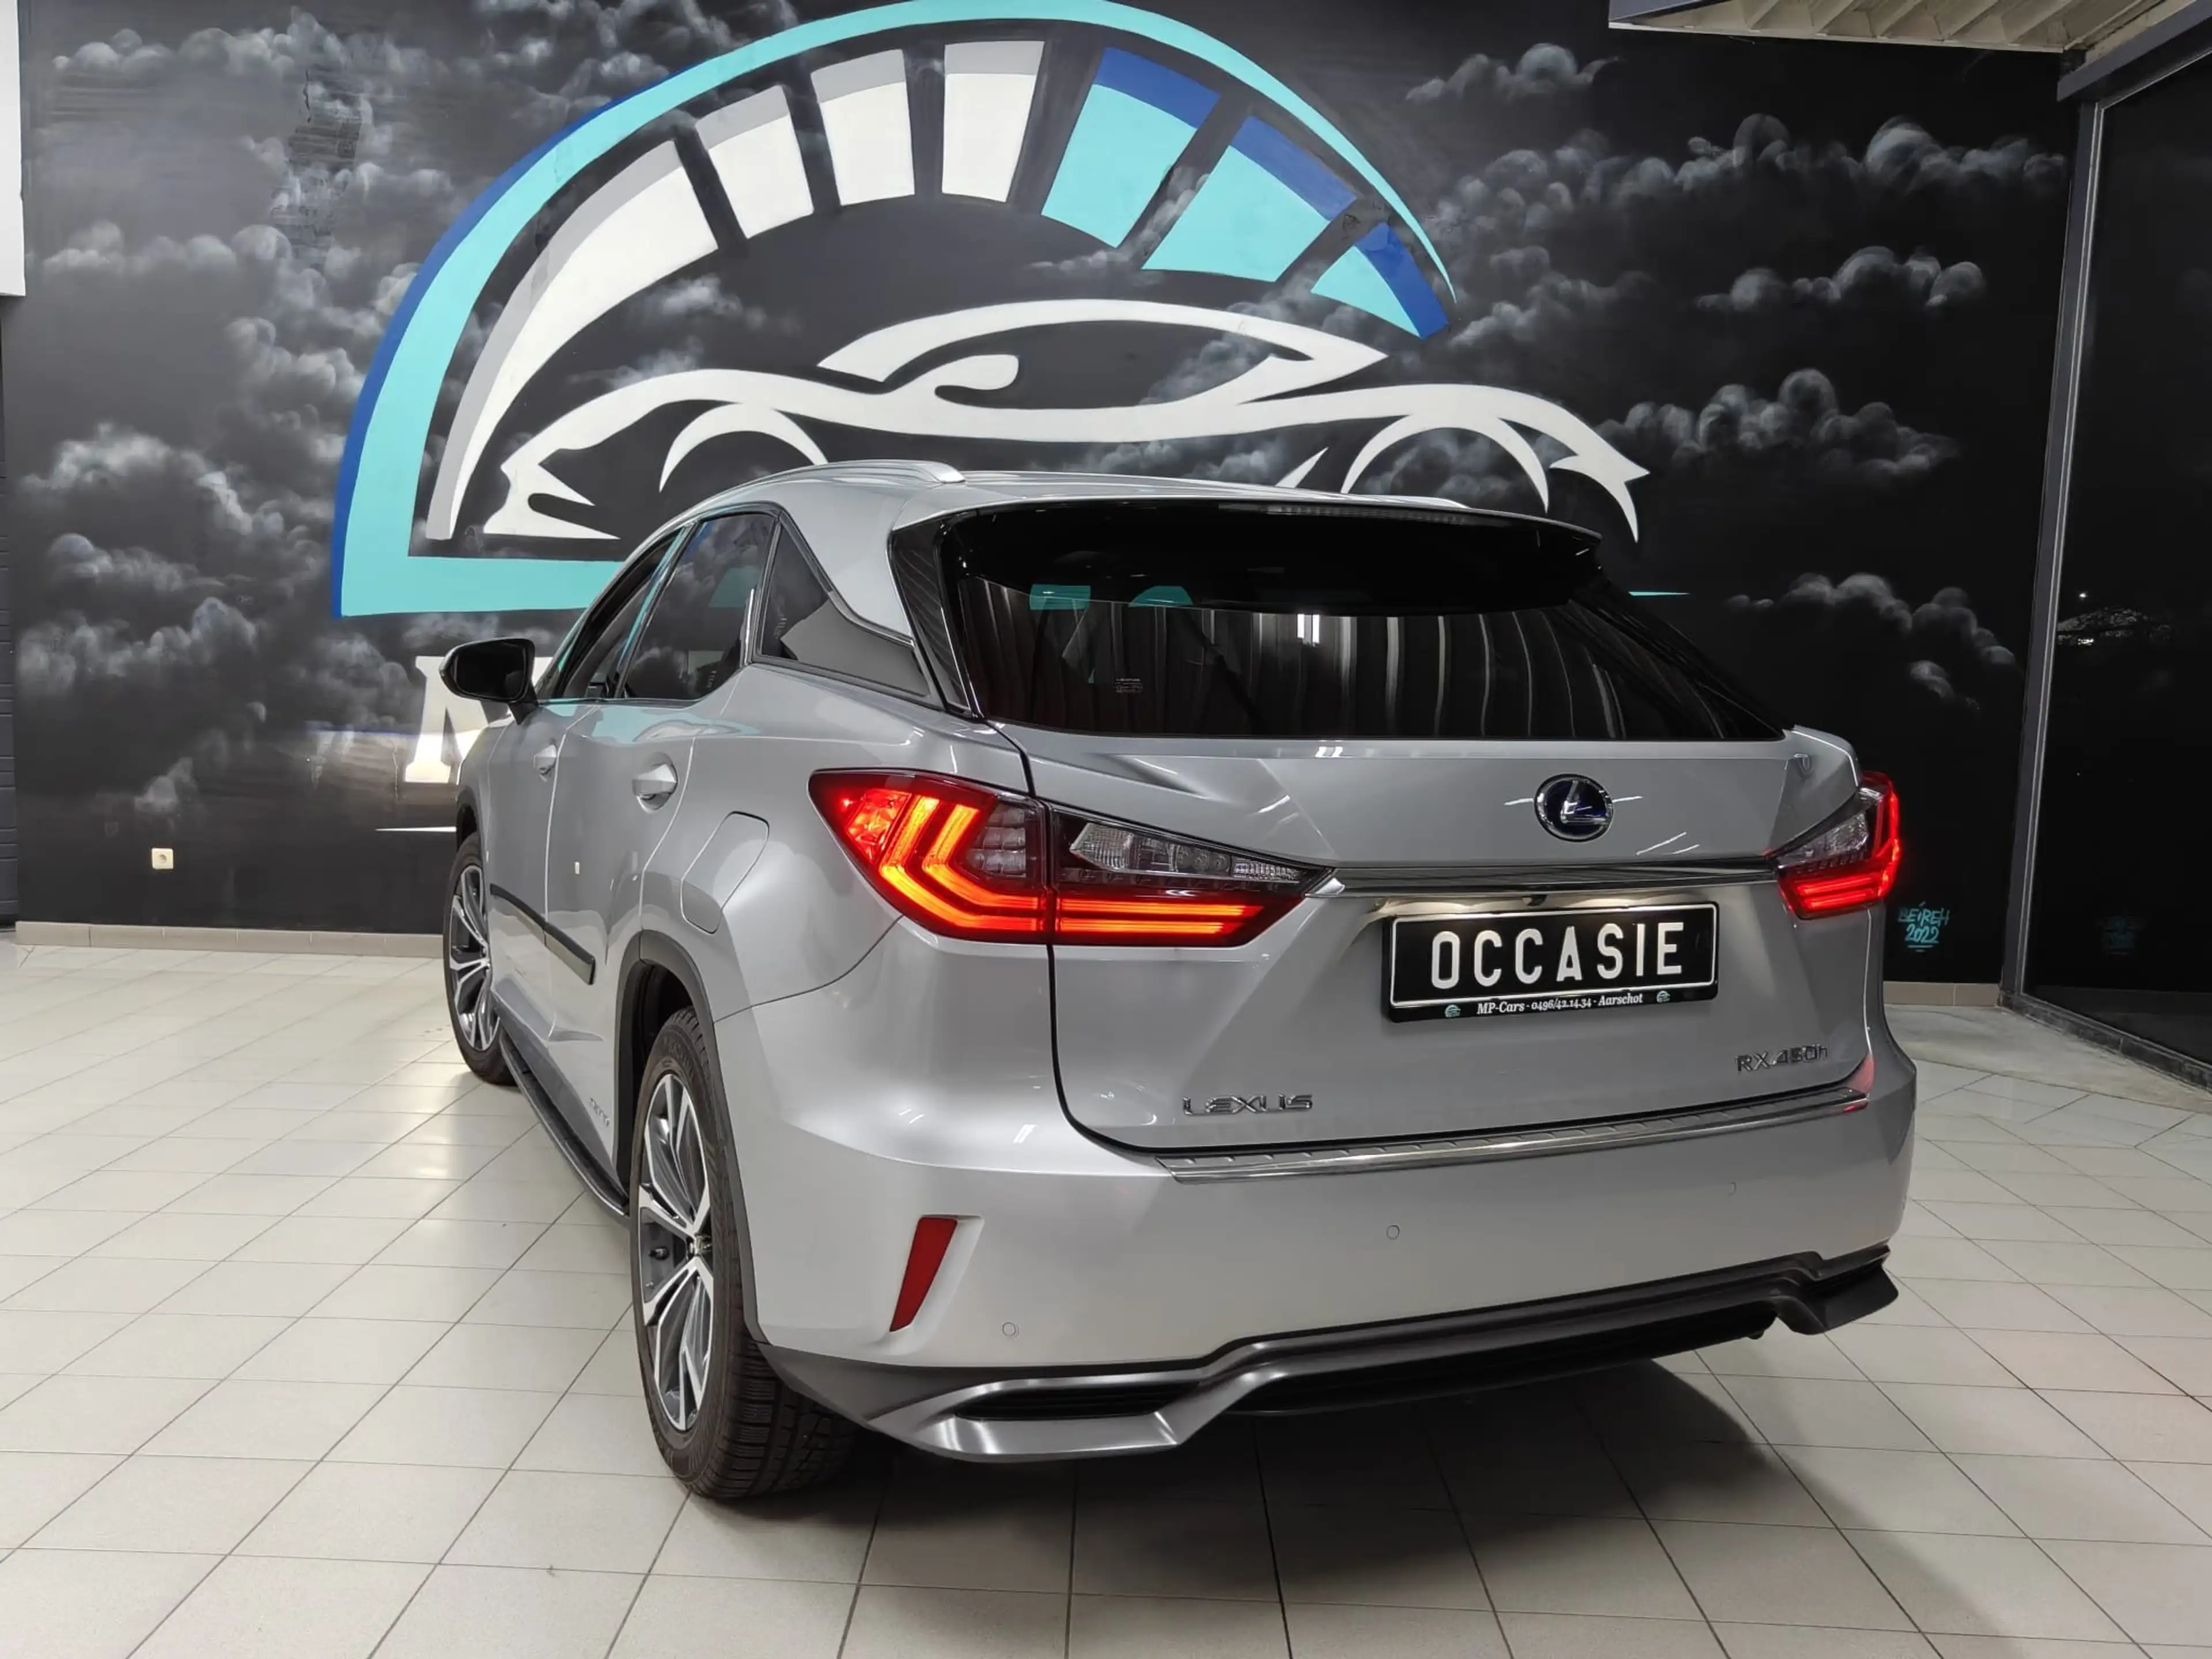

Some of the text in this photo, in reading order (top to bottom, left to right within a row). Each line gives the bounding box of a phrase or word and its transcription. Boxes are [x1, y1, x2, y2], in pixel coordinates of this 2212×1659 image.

[1904, 923, 1940, 944] 2022
[1431, 922, 1684, 989] OCCASIE
[1476, 1001, 1525, 1015] MP-Cars
[1598, 993, 1643, 1006] Aarschot
[1735, 1051, 1770, 1072] RX
[1183, 1093, 1313, 1115] LEXUS
